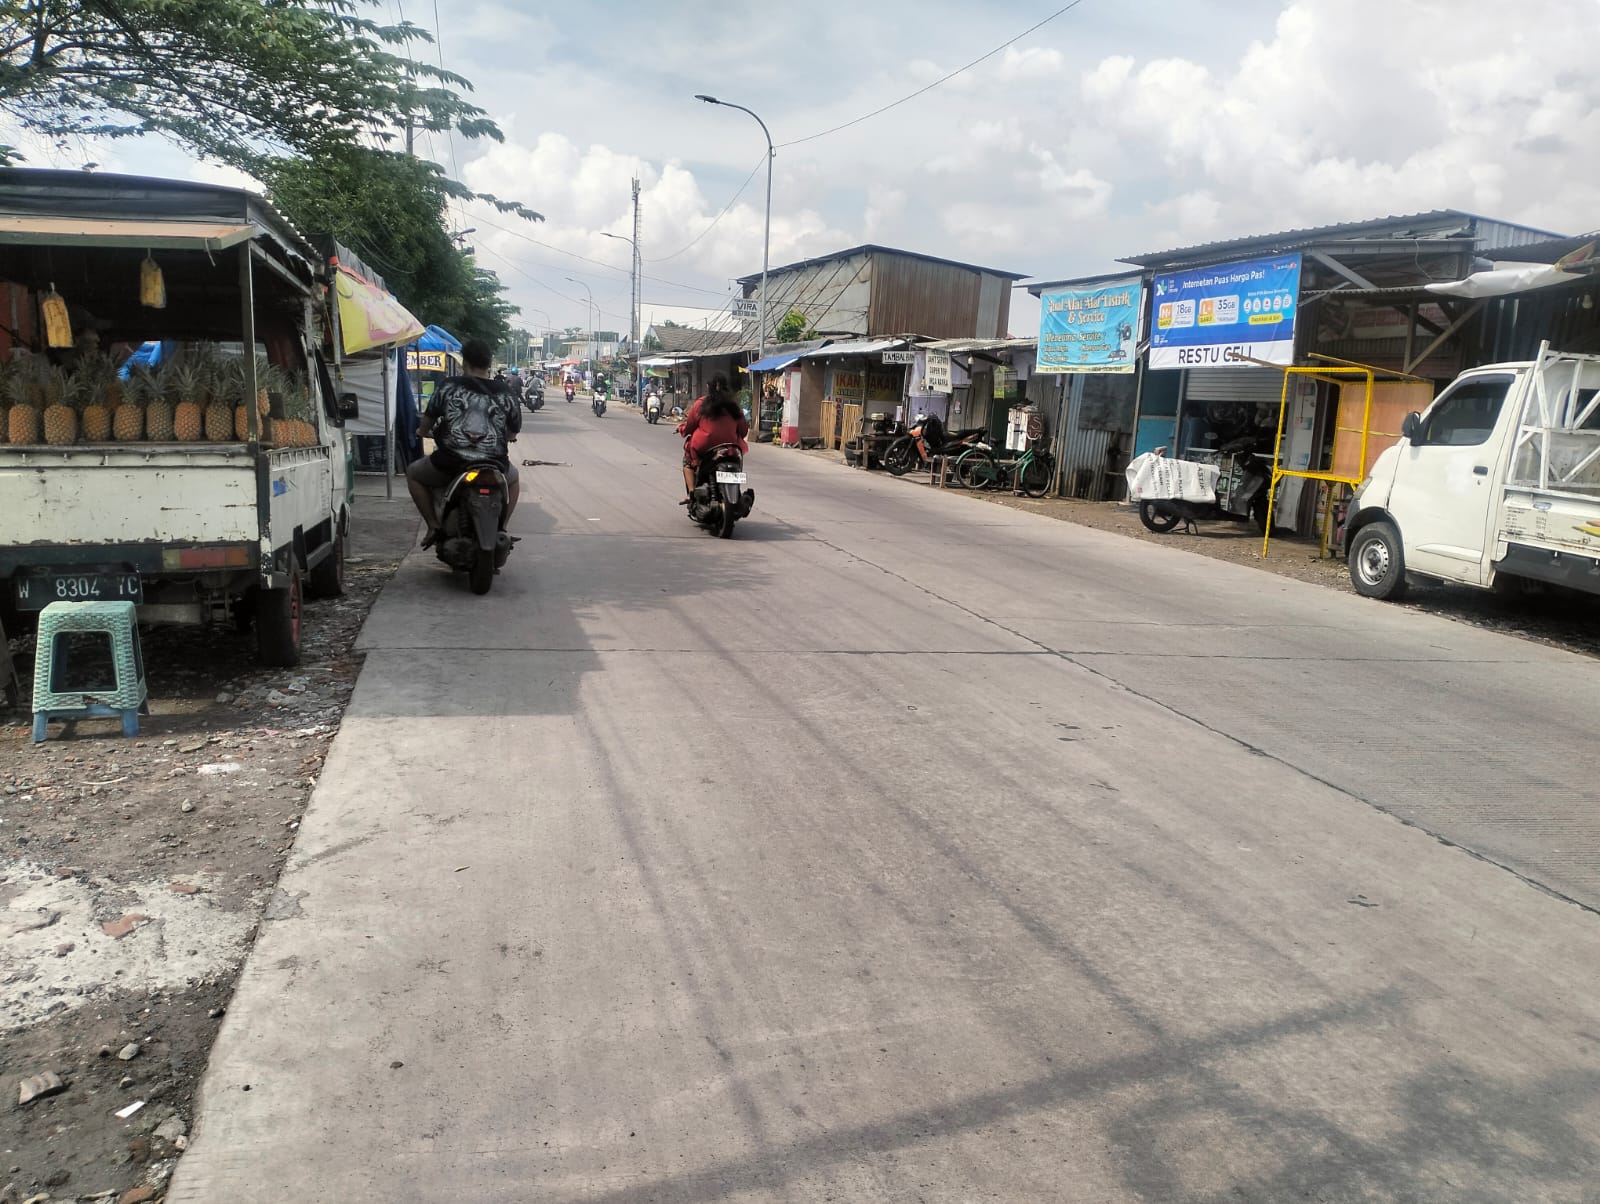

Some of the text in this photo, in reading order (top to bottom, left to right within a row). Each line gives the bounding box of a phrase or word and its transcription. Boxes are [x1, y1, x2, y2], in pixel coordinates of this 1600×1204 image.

[1182, 277, 1213, 289] Internetan
[1214, 276, 1229, 285] Puas
[1230, 272, 1250, 283] Harga
[1250, 269, 1265, 280] Pas!
[736, 302, 758, 311] VIRA
[1217, 299, 1236, 310] 35GB
[1067, 310, 1105, 326] & Service
[1178, 347, 1220, 364] RESTU
[835, 372, 860, 388] IKAN
[18, 579, 30, 599] W
[56, 577, 101, 598] 8304
